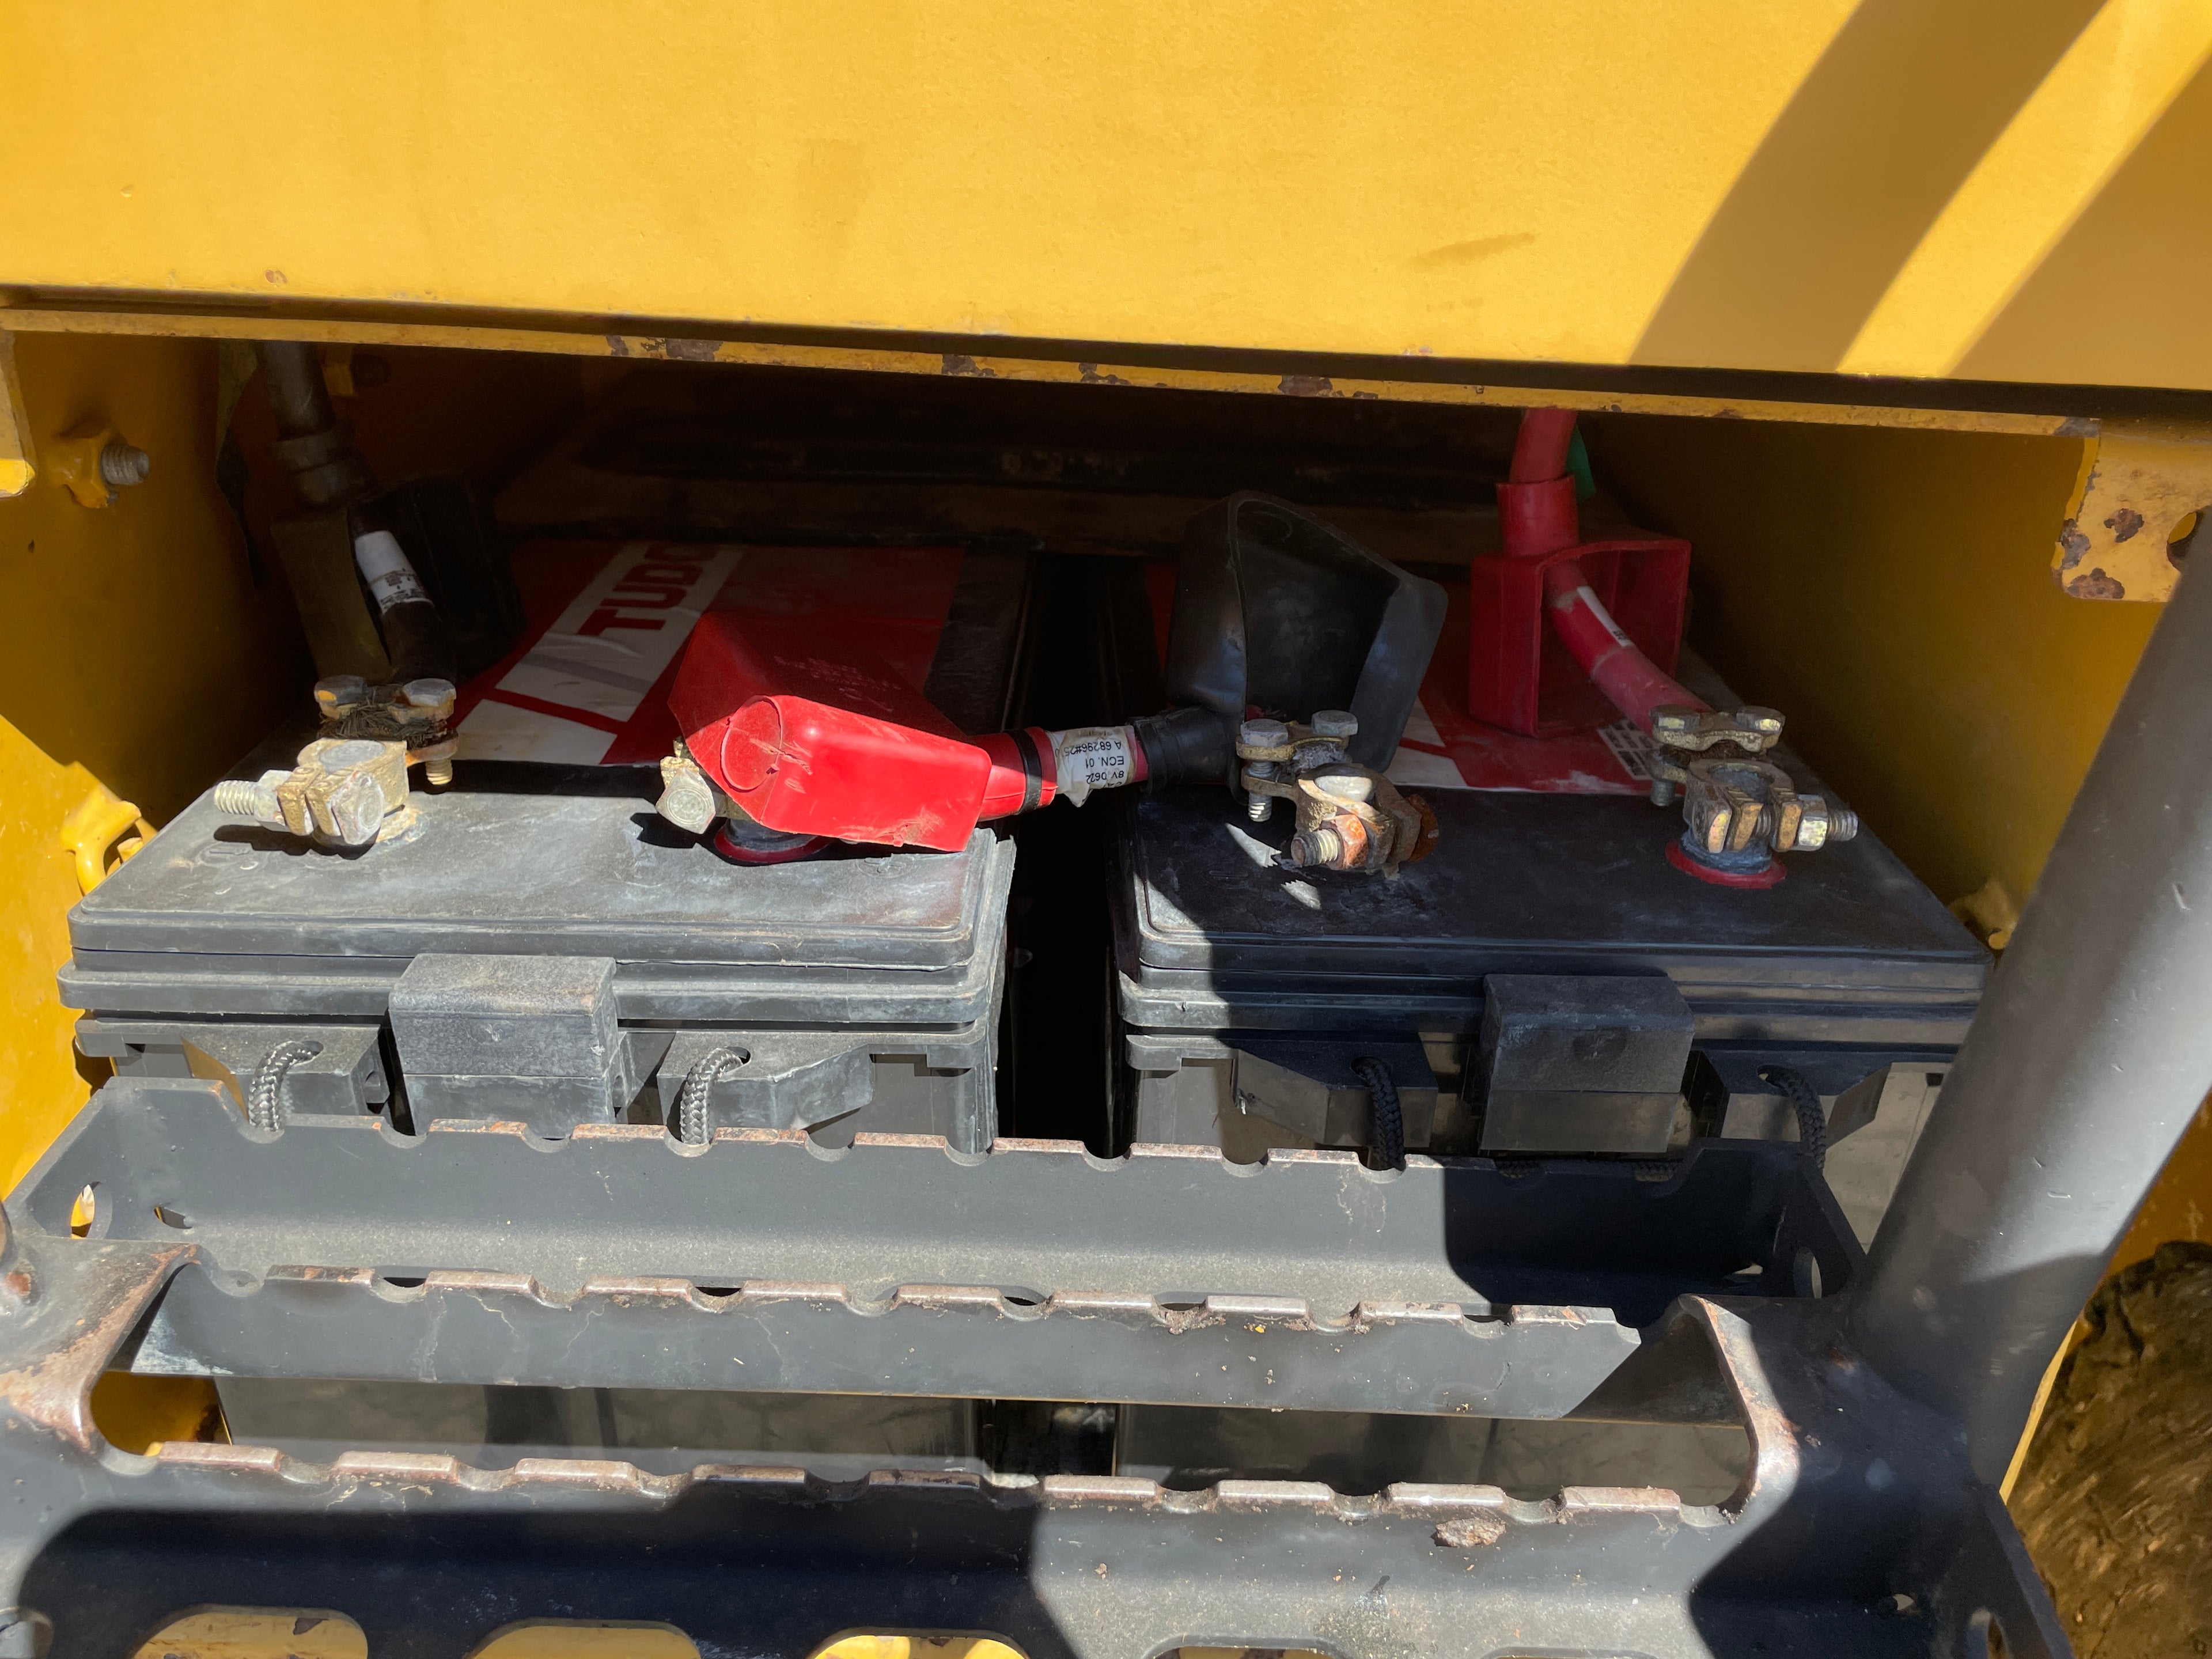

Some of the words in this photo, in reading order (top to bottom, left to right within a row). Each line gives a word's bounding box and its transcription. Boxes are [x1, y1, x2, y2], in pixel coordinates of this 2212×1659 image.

[1114, 741, 1122, 749] A
[1085, 758, 1094, 769] 01
[1098, 756, 1124, 766] ECN.
[1086, 772, 1107, 784] 0622
[1111, 771, 1124, 779] 8V
